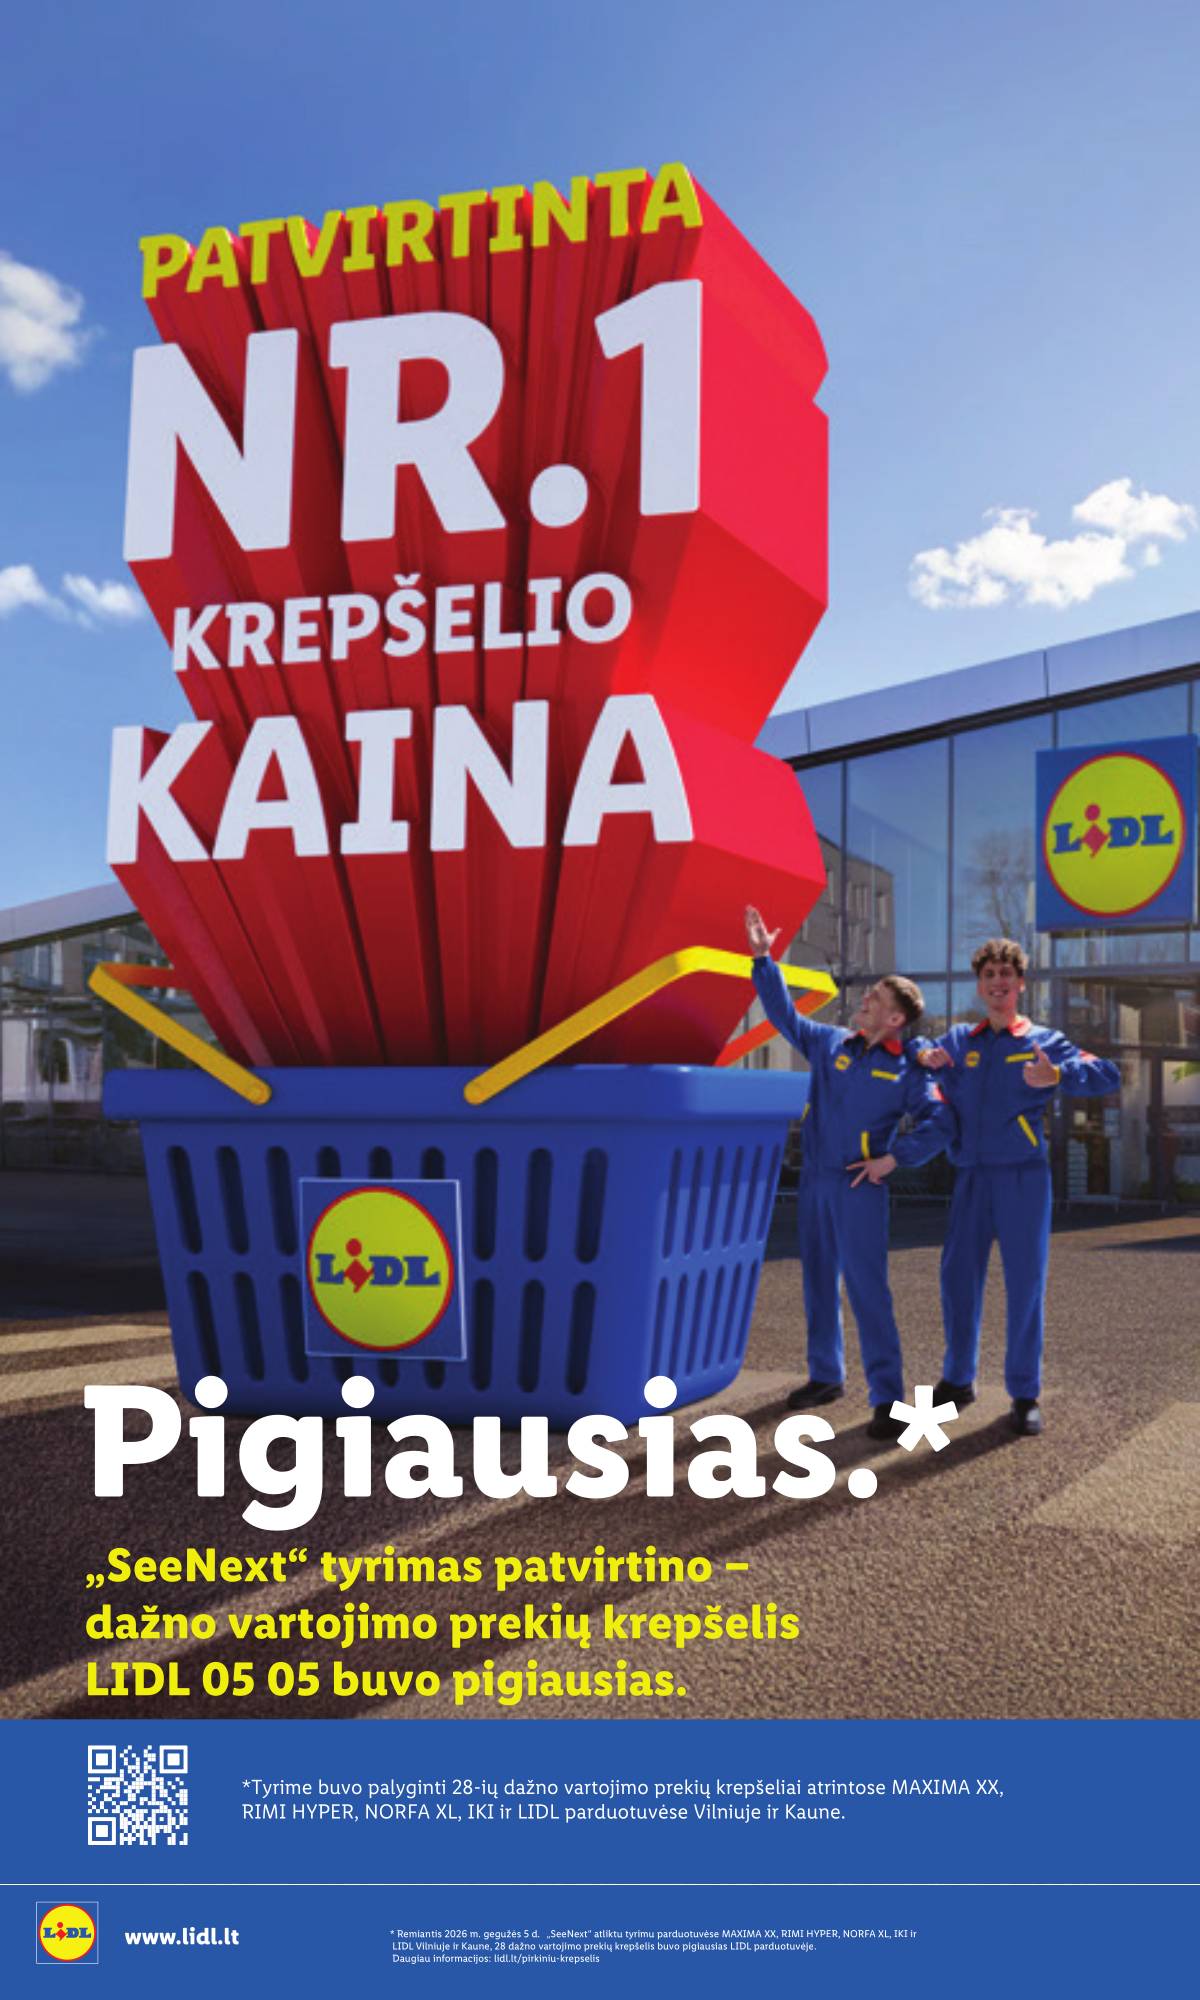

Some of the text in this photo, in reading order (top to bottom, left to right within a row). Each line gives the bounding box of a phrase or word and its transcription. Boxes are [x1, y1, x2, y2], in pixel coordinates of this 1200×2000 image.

[140, 163, 702, 297] PATVIRTINTA
[125, 281, 701, 561] NR.1
[173, 573, 631, 671] KREPŠELIO
[107, 695, 692, 864] KAINA
